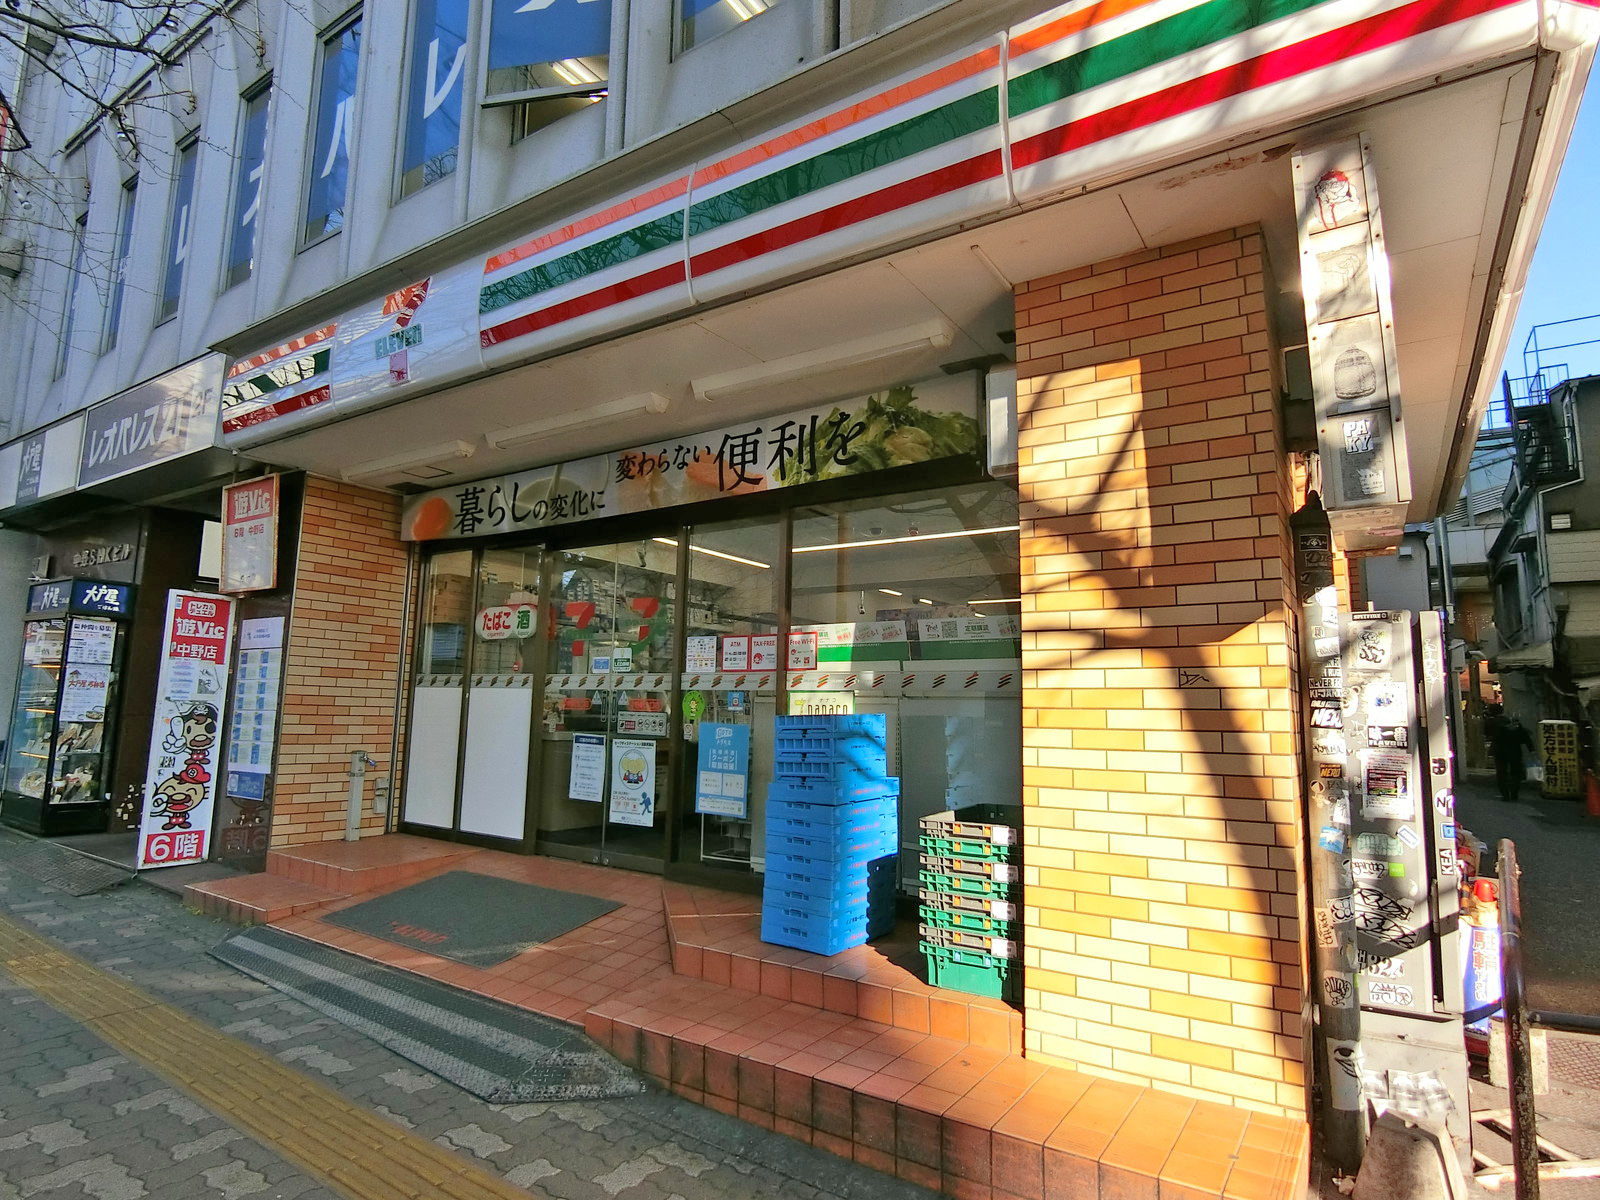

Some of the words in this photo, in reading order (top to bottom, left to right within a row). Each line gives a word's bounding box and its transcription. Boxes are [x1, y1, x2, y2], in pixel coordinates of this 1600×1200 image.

[88, 395, 184, 468] レオパレス21
[453, 486, 607, 535] 暮らしの変化に
[82, 585, 120, 605] 大戸屋
[483, 611, 511, 631] たばこ
[517, 610, 530, 629] 酒
[177, 643, 218, 660] 中野店
[1543, 724, 1558, 786] 処方せん受付
[150, 836, 199, 861] 6階
